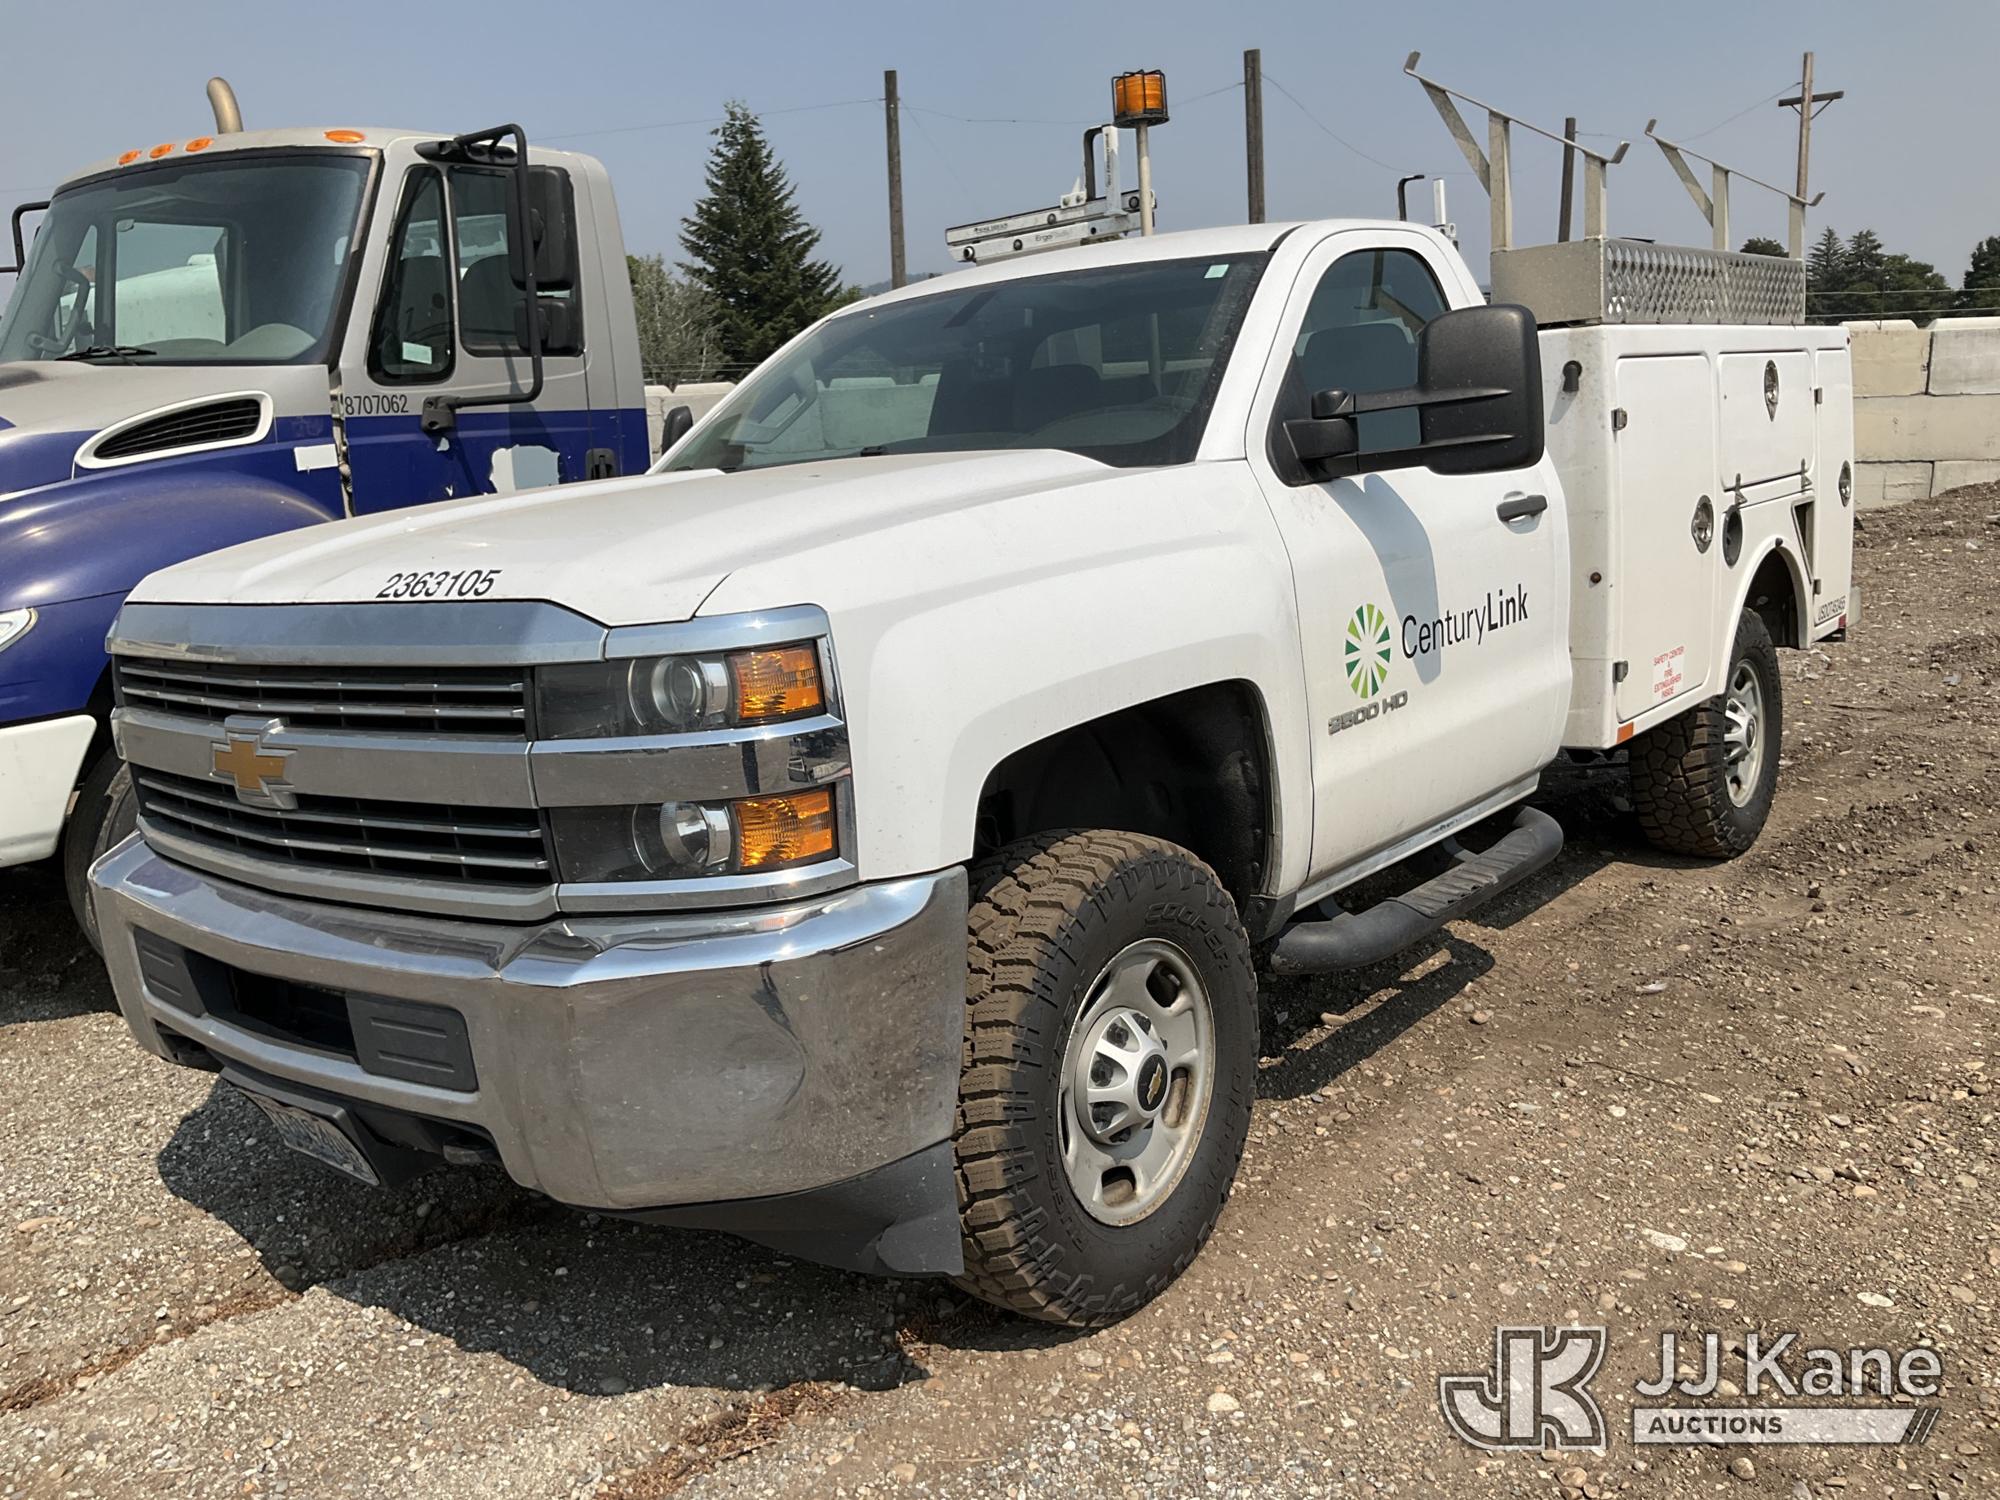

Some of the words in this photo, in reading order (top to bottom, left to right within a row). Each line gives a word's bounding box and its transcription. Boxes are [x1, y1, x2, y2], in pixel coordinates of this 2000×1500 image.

[344, 394, 409, 415] 8707062
[375, 569, 503, 598] 2363105
[1401, 583, 1528, 659] CenturyLink
[1382, 690, 1408, 715] HD
[1144, 901, 1231, 971] COOPER
